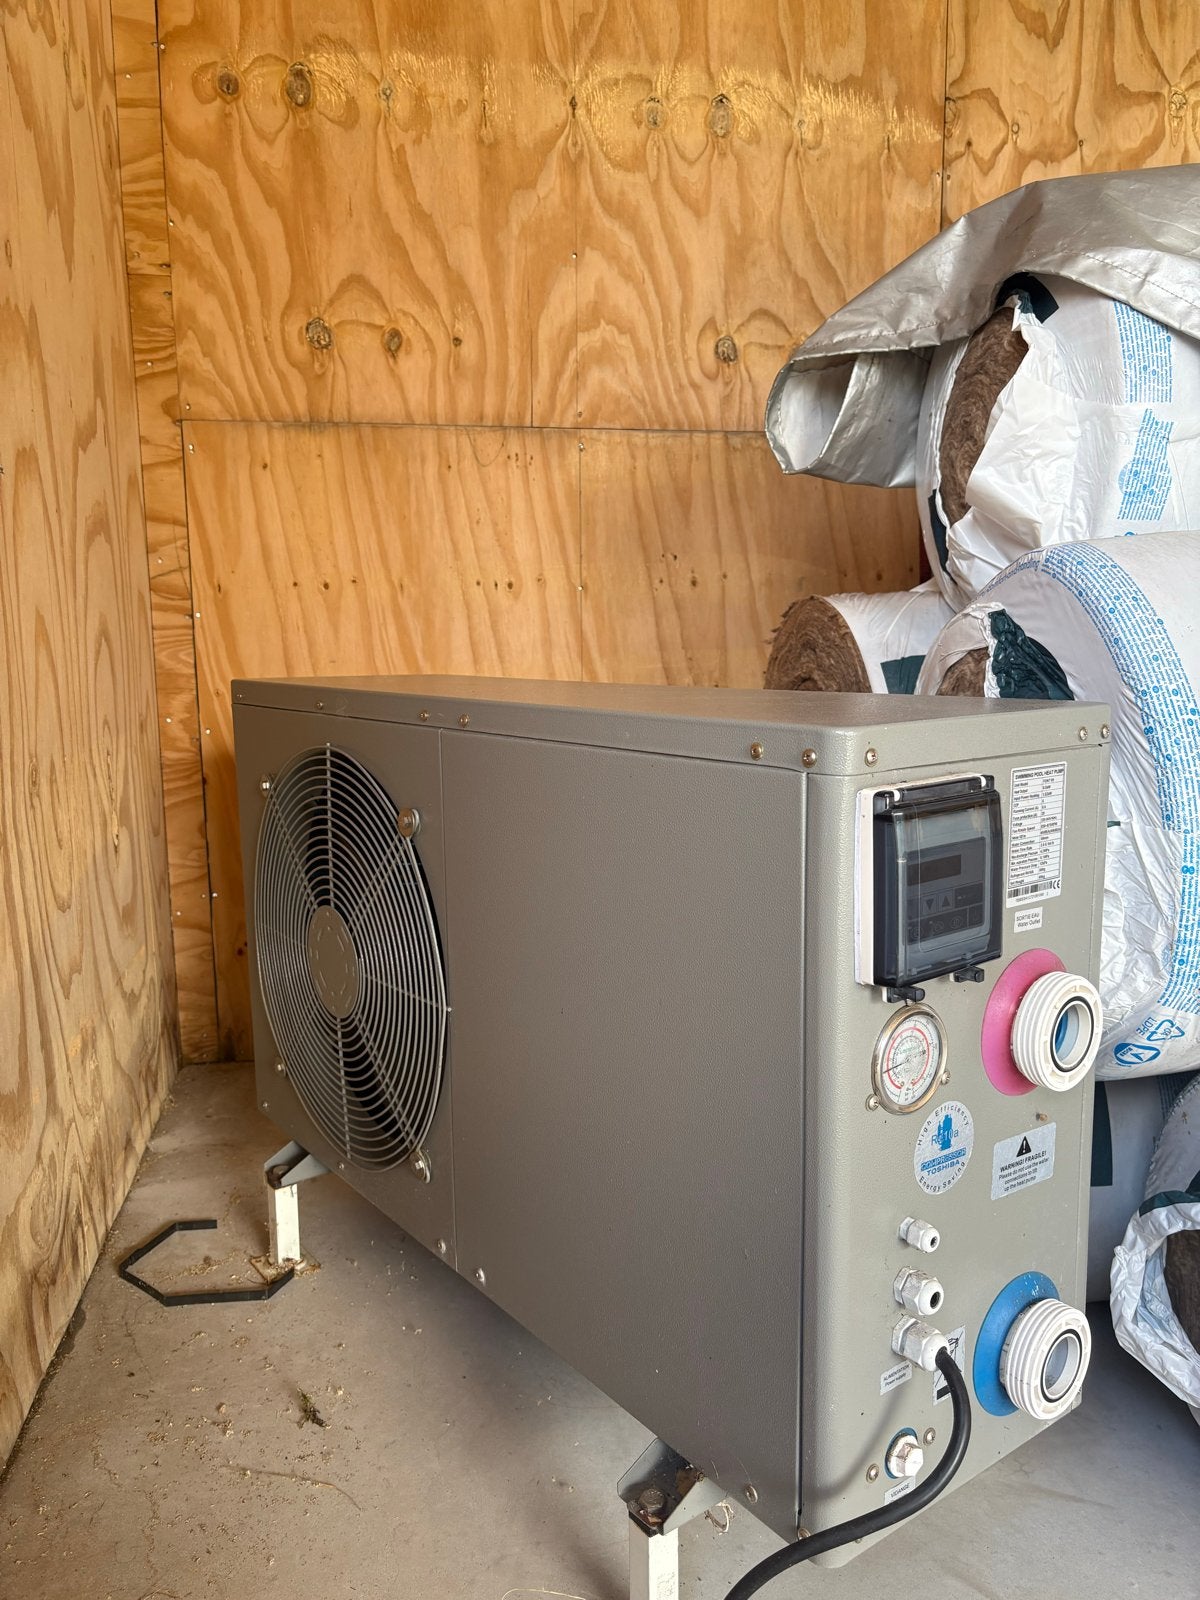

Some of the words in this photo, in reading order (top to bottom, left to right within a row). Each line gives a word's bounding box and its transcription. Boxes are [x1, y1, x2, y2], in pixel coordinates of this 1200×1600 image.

[1136, 1017, 1157, 1036] LDPE
[917, 1120, 932, 1146] High
[935, 1105, 969, 1126] Efficiency
[921, 1148, 966, 1171] COMPRESSOR
[927, 1160, 960, 1176] TOSHIBA
[1000, 1159, 1024, 1172] WARNING!
[1025, 1151, 1046, 1163] FRAGILE!
[919, 1175, 941, 1192] Energy
[943, 1161, 965, 1188] Saving
[999, 1171, 1012, 1180] Please
[1005, 1173, 1027, 1184] connections
